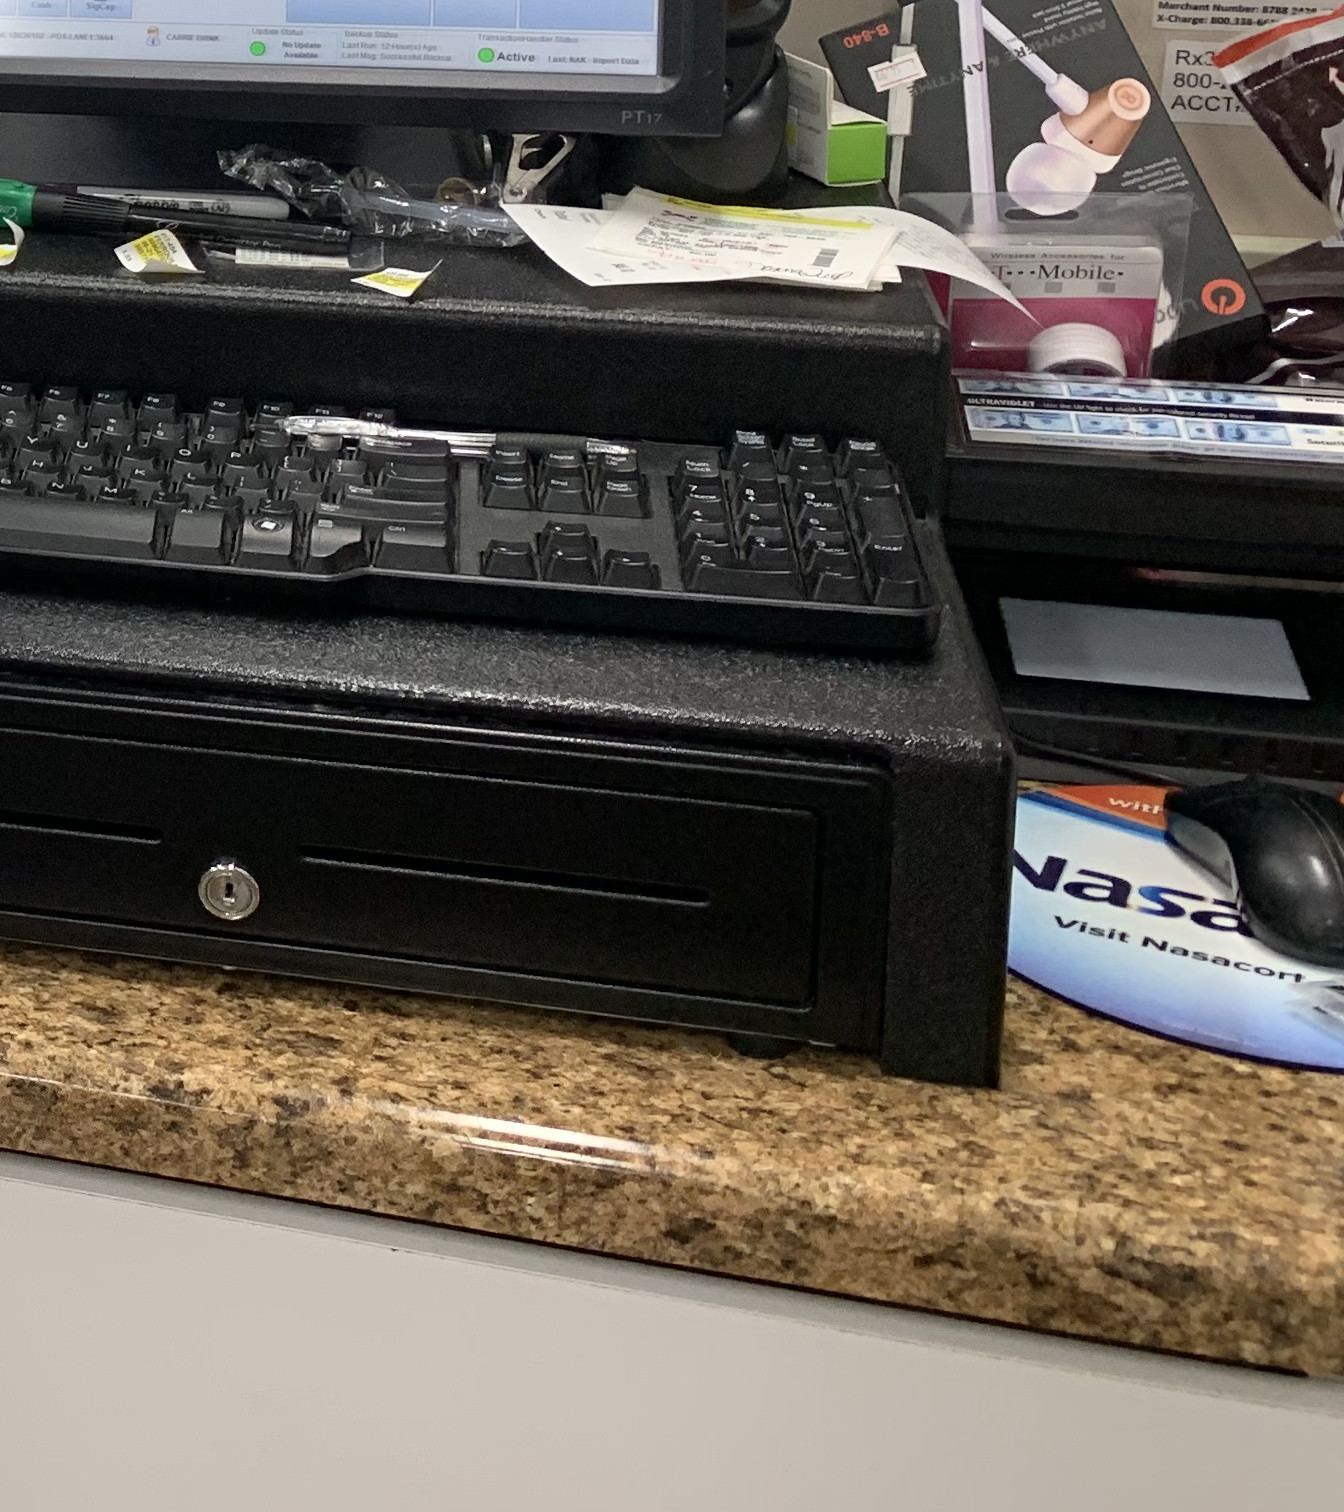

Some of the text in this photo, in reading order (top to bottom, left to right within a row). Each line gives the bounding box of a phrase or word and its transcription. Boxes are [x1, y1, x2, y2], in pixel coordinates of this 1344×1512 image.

[1157, 1, 1260, 14] Merchant Number:
[842, 22, 890, 49] B-840
[496, 50, 536, 63] Active
[1054, 914, 1306, 984] Visit Nasacort
